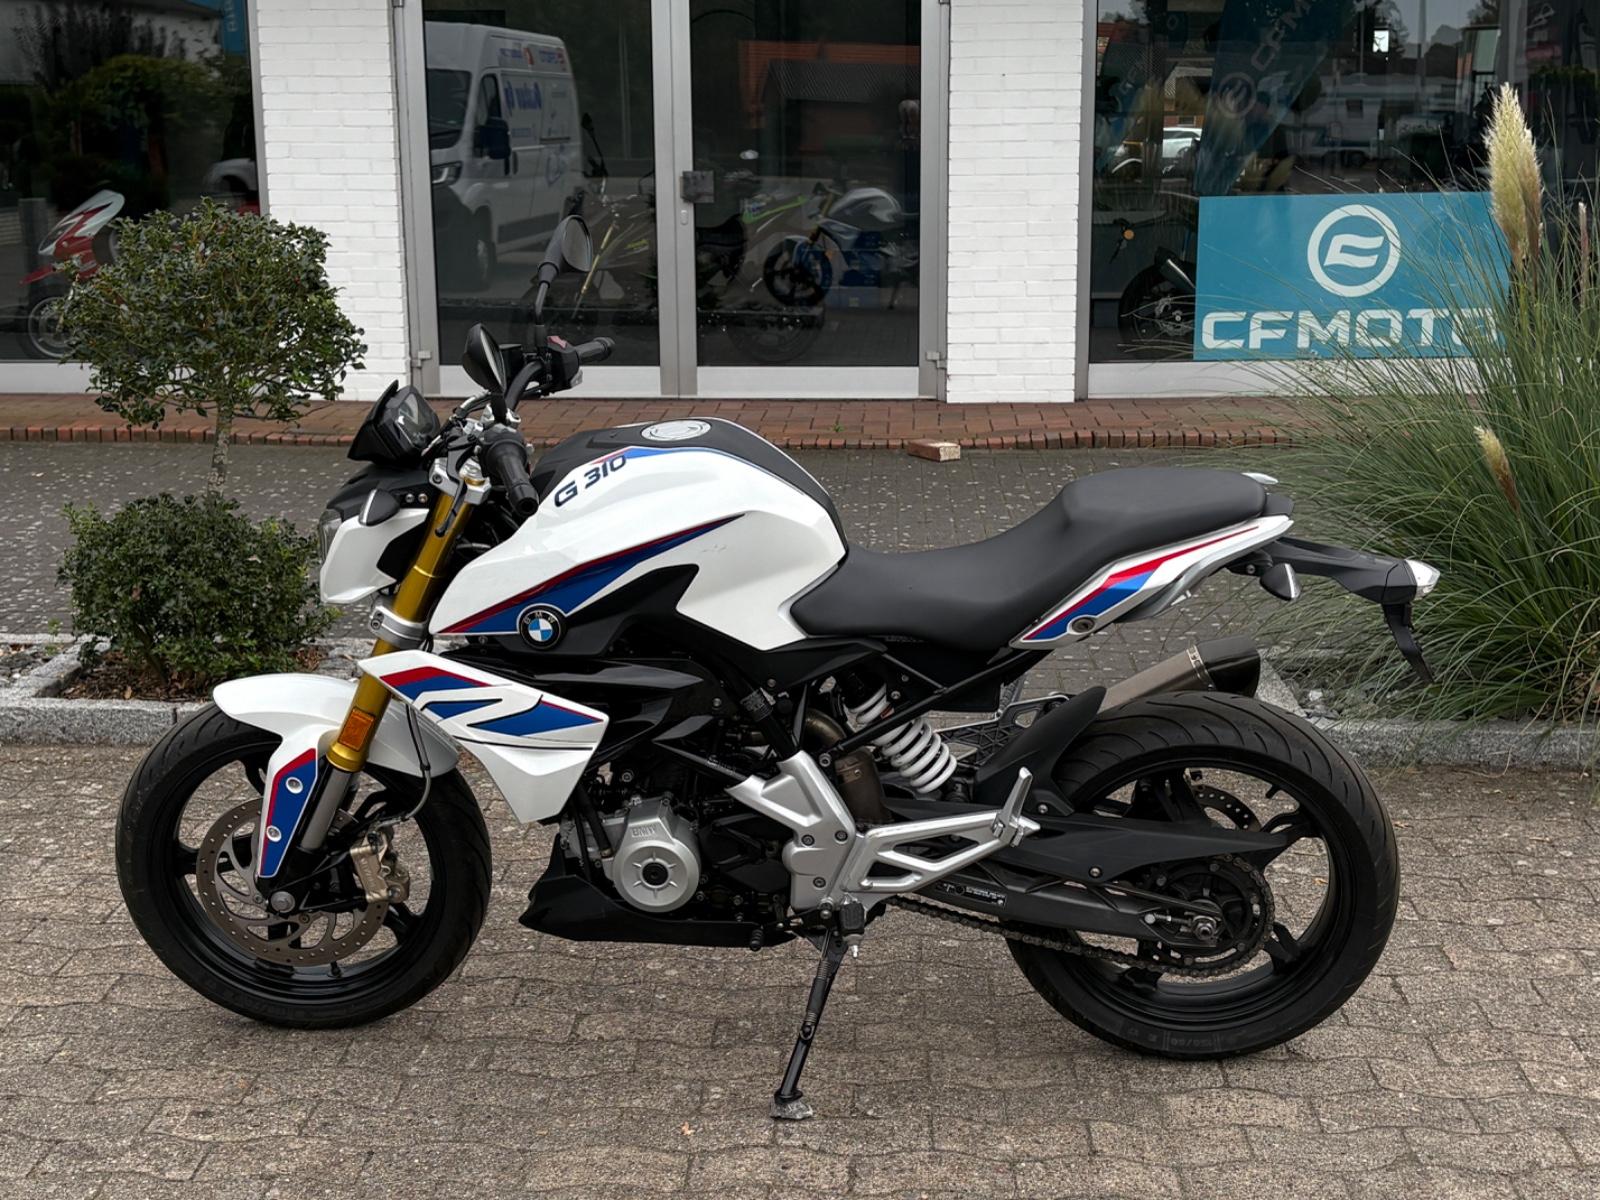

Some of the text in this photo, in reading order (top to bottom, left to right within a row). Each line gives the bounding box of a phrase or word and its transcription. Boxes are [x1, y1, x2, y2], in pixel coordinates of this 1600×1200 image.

[555, 455, 626, 507] G 310
[522, 610, 558, 625] BMW
